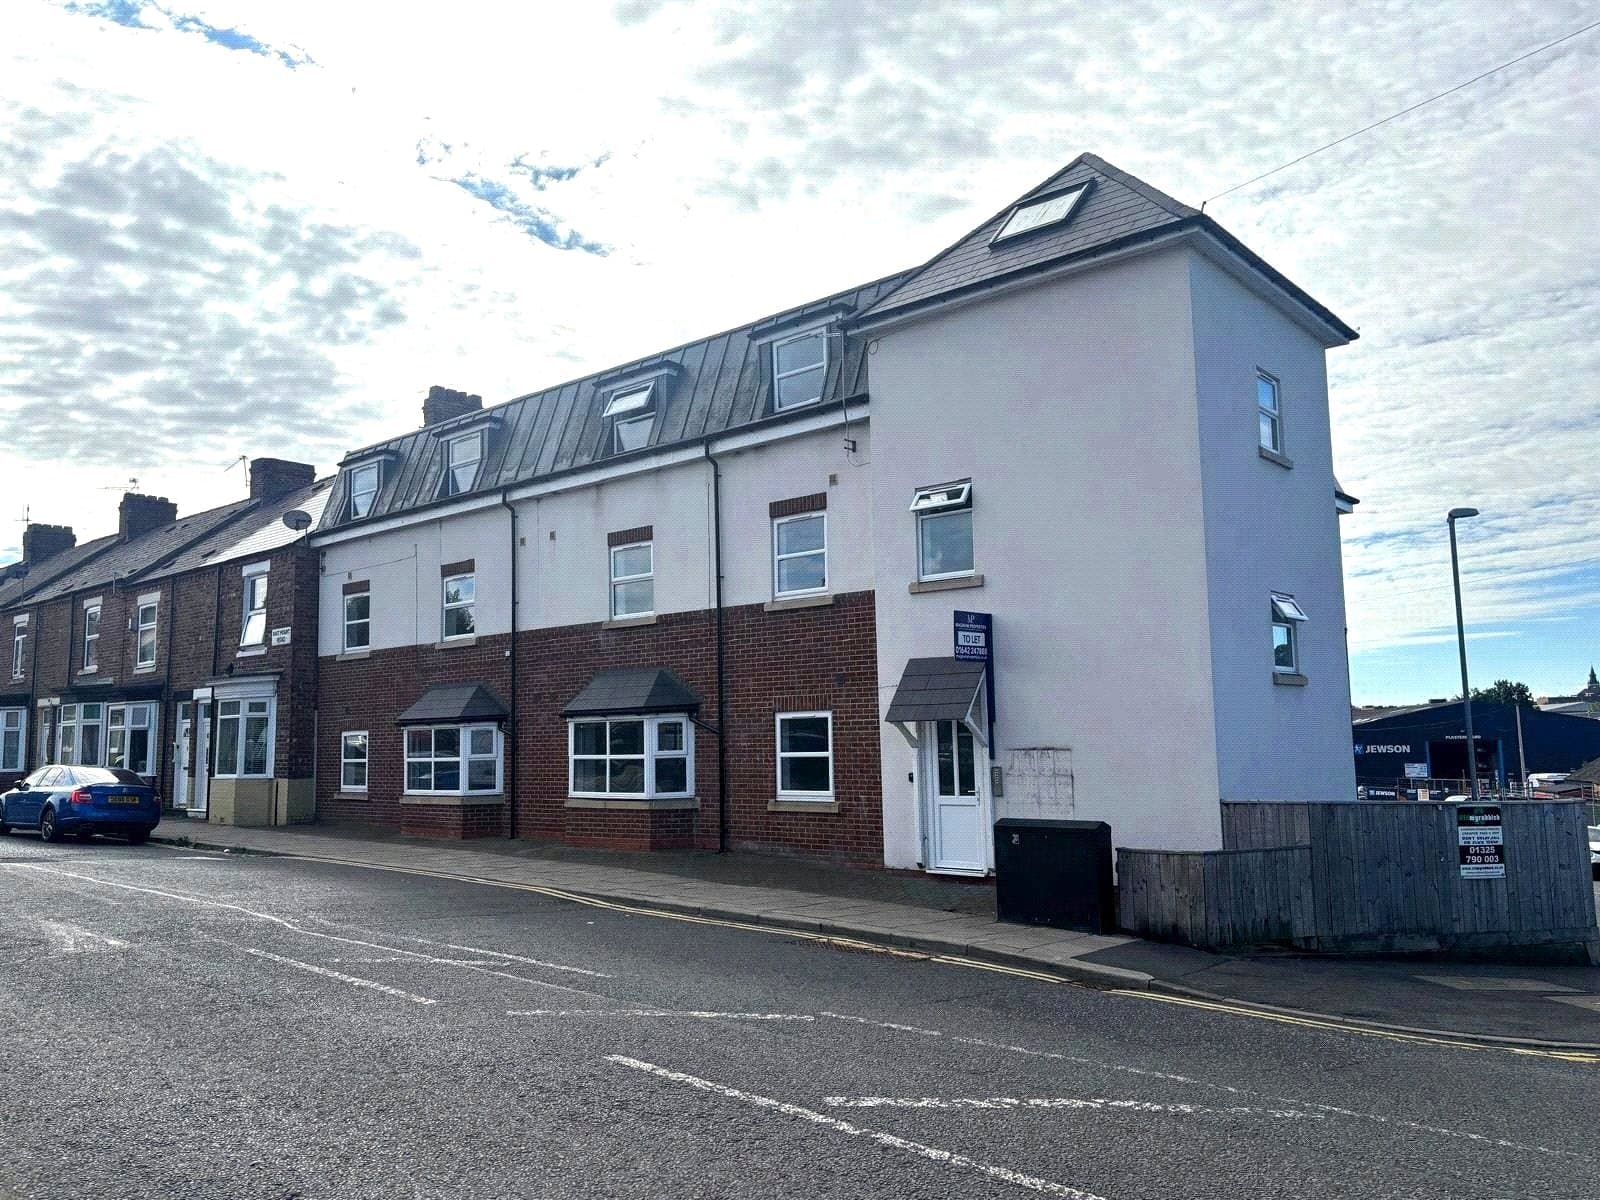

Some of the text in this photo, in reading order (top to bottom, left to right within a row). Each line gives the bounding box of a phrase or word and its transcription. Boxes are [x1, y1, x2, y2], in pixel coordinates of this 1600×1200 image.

[962, 634, 981, 644] TO LET
[1365, 744, 1411, 754] JEWSON
[1469, 846, 1495, 854] 01325
[1465, 855, 1499, 863] 790 003
